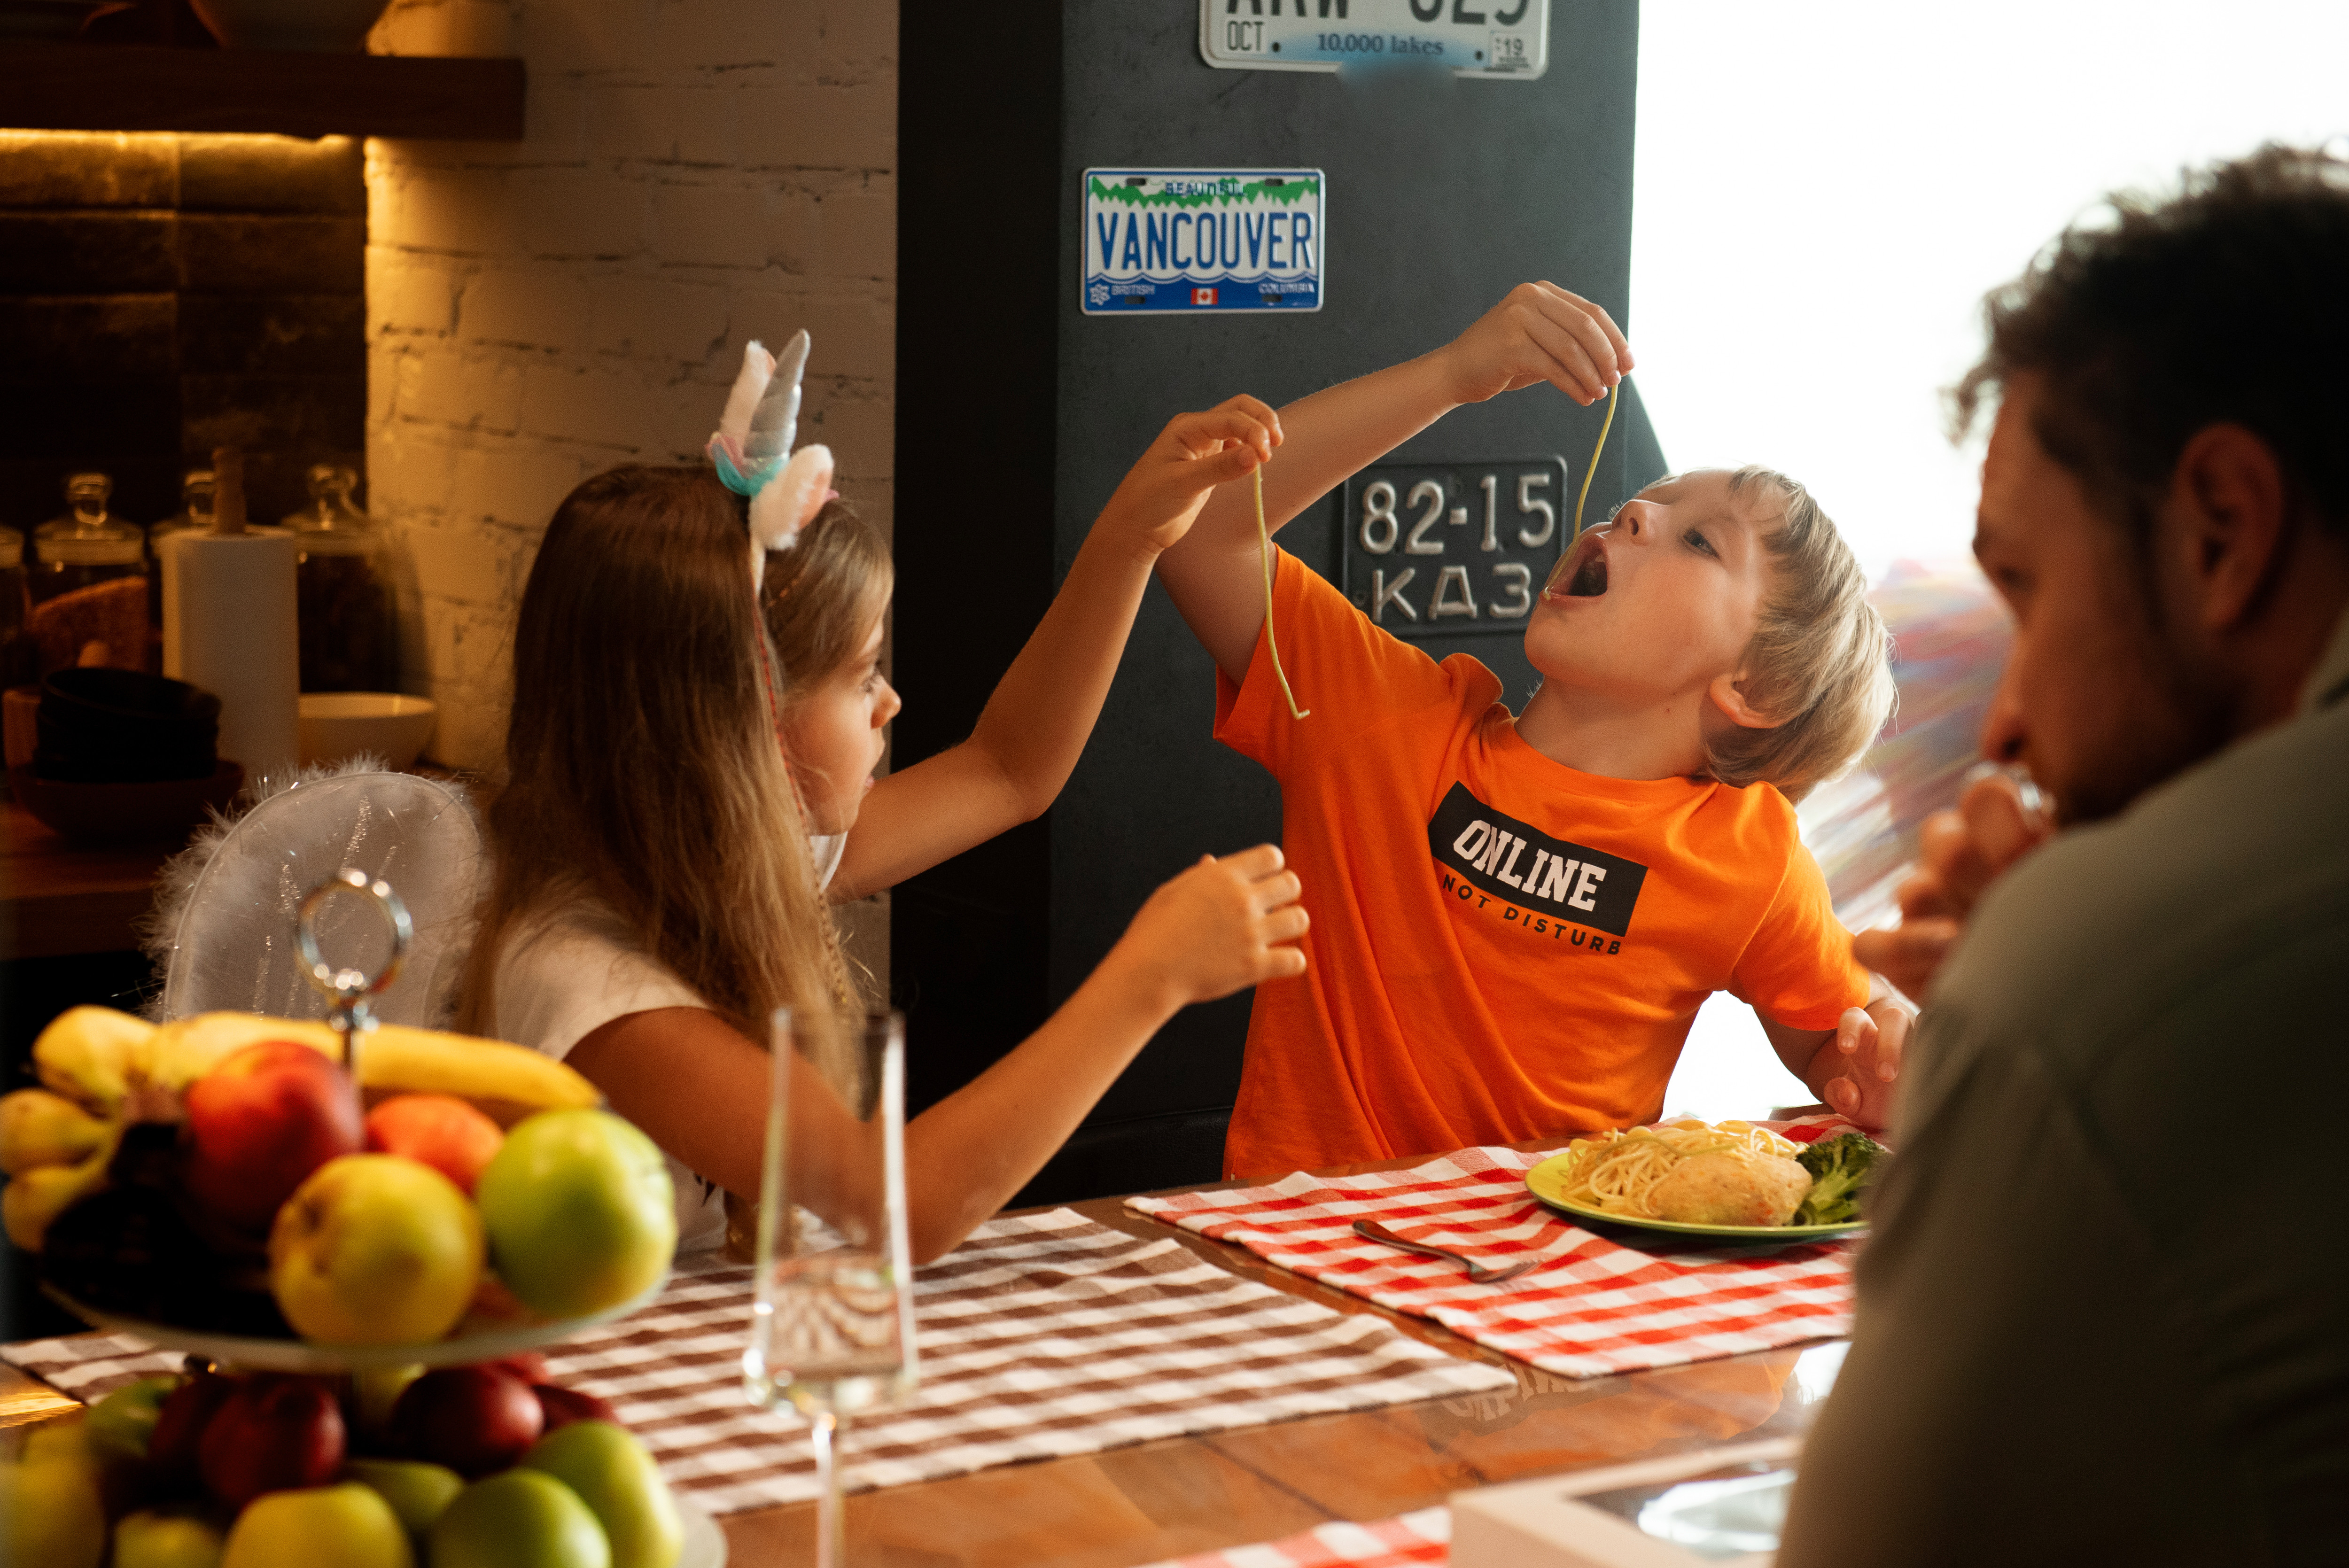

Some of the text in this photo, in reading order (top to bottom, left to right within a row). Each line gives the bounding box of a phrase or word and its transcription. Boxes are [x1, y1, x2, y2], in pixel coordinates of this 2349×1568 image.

[1227, 20, 1264, 51] OCT
[1318, 33, 1444, 55] 10,000 lakes
[1097, 211, 1315, 271] VANCOUVER
[1360, 474, 1555, 556] 82-15
[1453, 820, 1607, 912] ONLINE
[1442, 874, 1622, 955] NOT DISTURB
